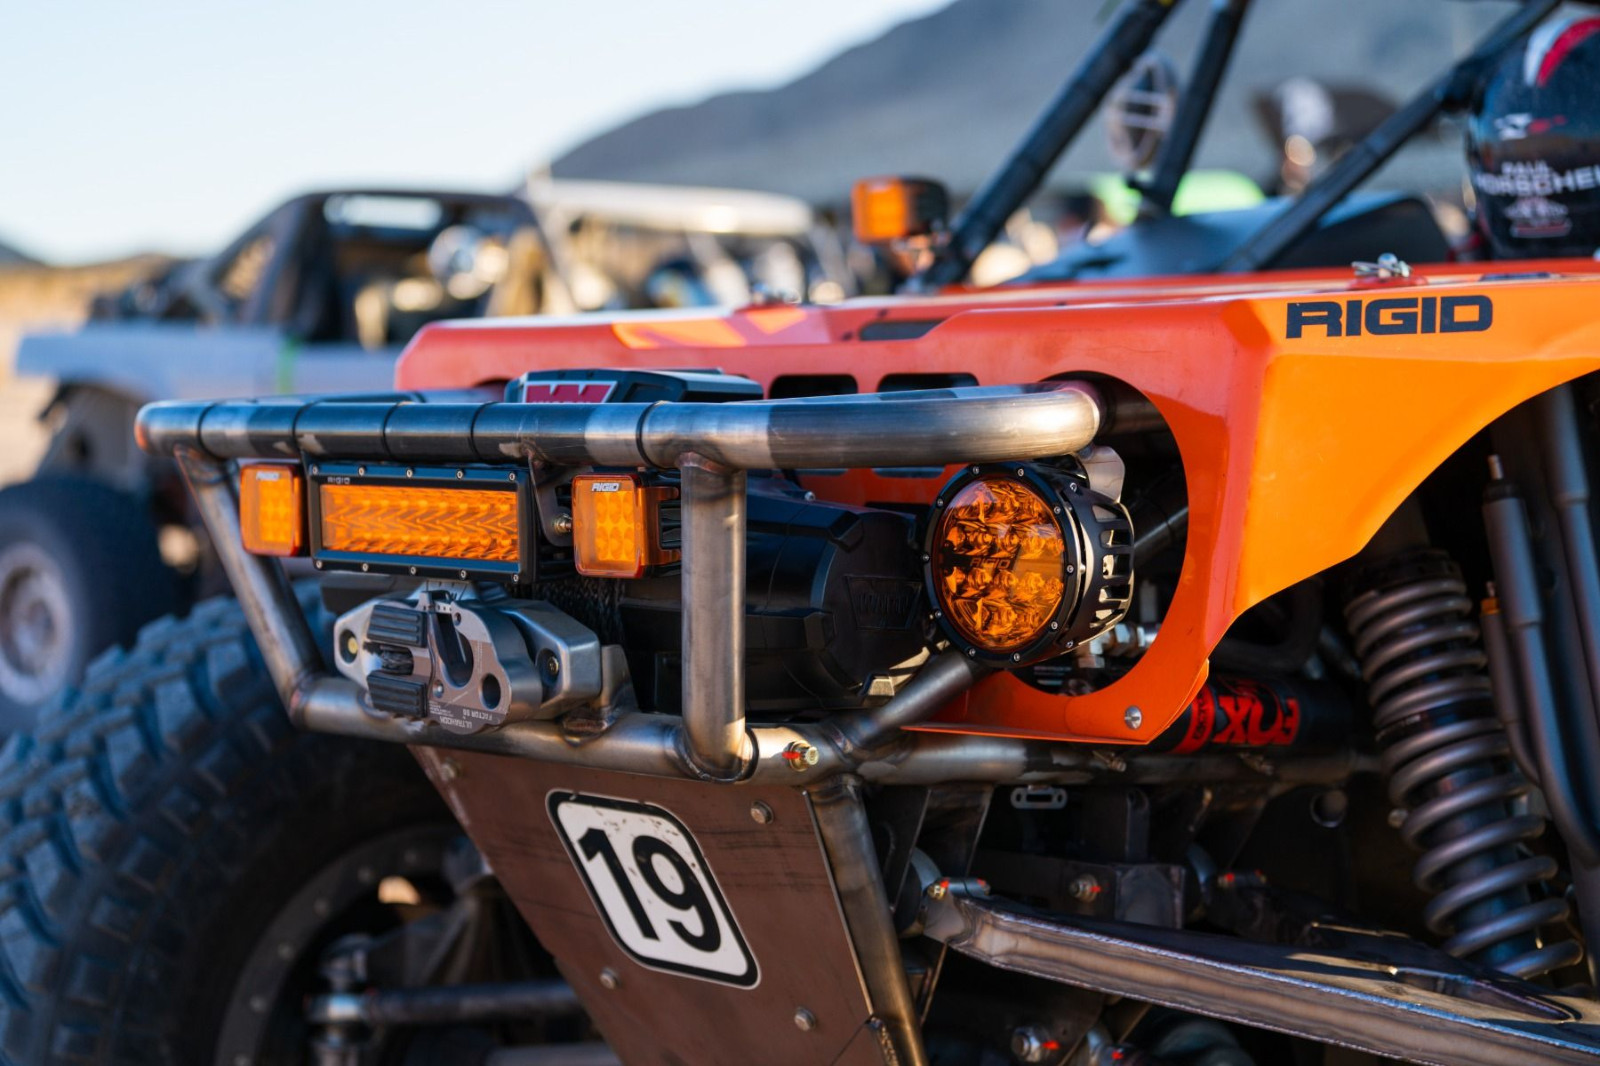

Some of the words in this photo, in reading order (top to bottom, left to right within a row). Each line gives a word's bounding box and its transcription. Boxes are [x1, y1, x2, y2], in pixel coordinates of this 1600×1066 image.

[1286, 294, 1493, 338] RIGID
[592, 482, 620, 492] RIGID
[1212, 692, 1300, 746] FOX
[577, 827, 722, 953] 19
